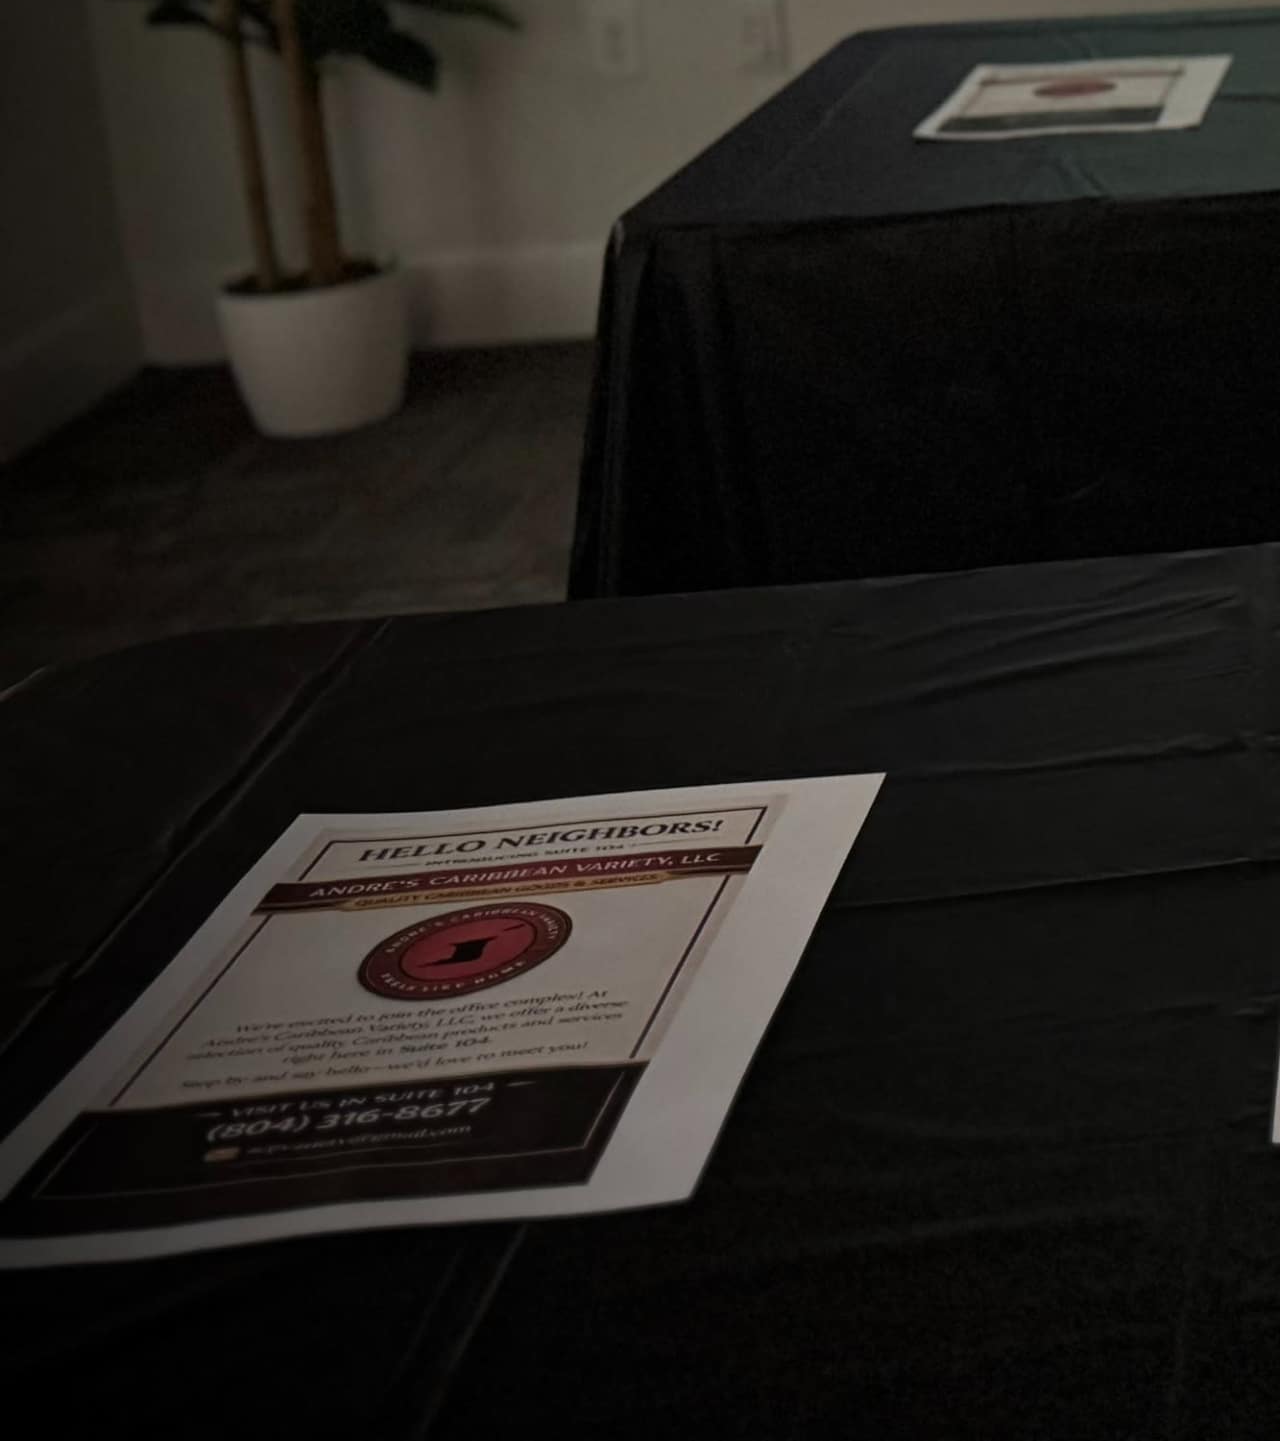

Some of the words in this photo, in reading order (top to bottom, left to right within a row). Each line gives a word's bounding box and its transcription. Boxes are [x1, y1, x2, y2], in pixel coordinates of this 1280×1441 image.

[358, 840, 486, 862] HELLO
[495, 820, 724, 850] NEIGHBORS!
[310, 878, 421, 897] ANDRE'S
[429, 865, 568, 885] CARIBBEAN
[576, 856, 673, 872] VARIETY,
[680, 852, 720, 864] LLC
[236, 1023, 284, 1033] We're
[287, 1014, 353, 1028] excited
[356, 1014, 375, 1022] to
[377, 1012, 412, 1021] join
[416, 1008, 447, 1017] the
[448, 1002, 500, 1013] office
[503, 991, 584, 1008] complex!
[587, 990, 608, 999] At
[207, 1114, 310, 1142] (804)
[316, 1097, 491, 1129] 316-8677
[232, 1102, 292, 1117] VISIT
[299, 1101, 331, 1111] US
[339, 1097, 367, 1107] IN
[375, 1089, 438, 1102] SUITE
[454, 1082, 494, 1095] 104
